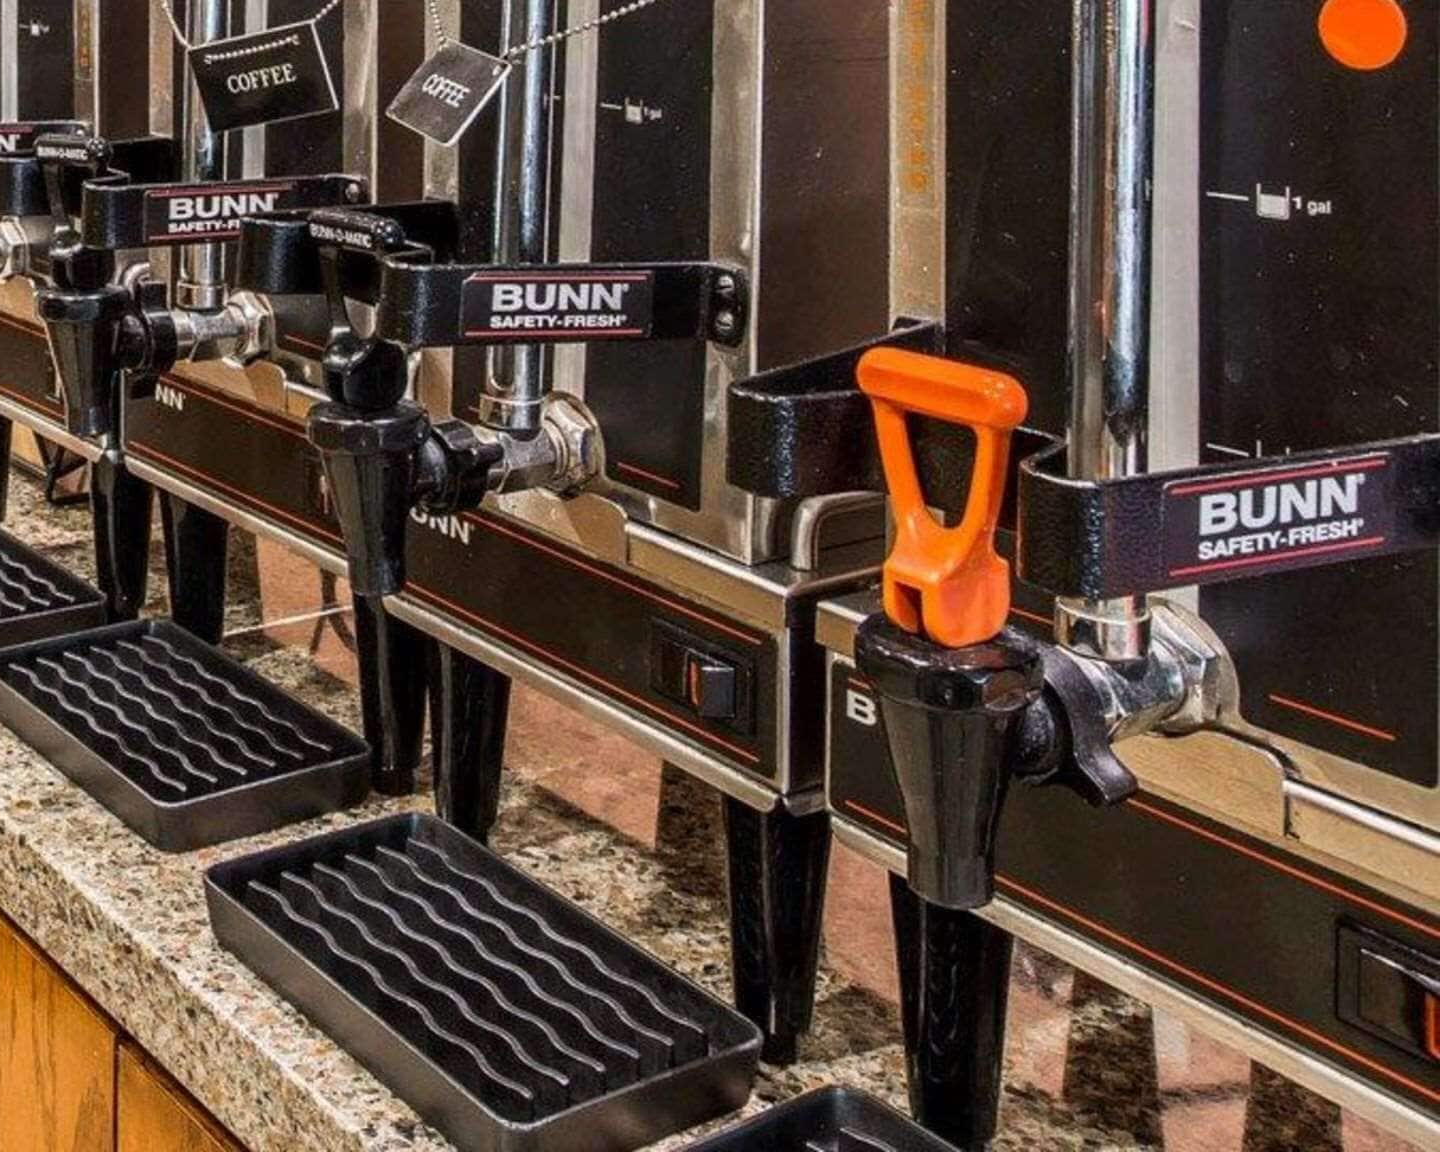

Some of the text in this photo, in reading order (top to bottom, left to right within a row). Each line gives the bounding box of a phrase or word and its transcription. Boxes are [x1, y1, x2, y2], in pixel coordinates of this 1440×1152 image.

[226, 62, 297, 94] COFFEE
[421, 73, 471, 108] COFFEE
[168, 192, 275, 221] BUNN
[1307, 199, 1332, 216] gal
[168, 219, 240, 234] SAFETY-F
[491, 282, 624, 312] BUNN
[490, 314, 623, 329] SAFETY-FRESH
[155, 383, 183, 411] NN
[1198, 474, 1359, 537] BUNN
[409, 506, 469, 545] UNN
[1198, 519, 1360, 560] SAFETY-FRESH
